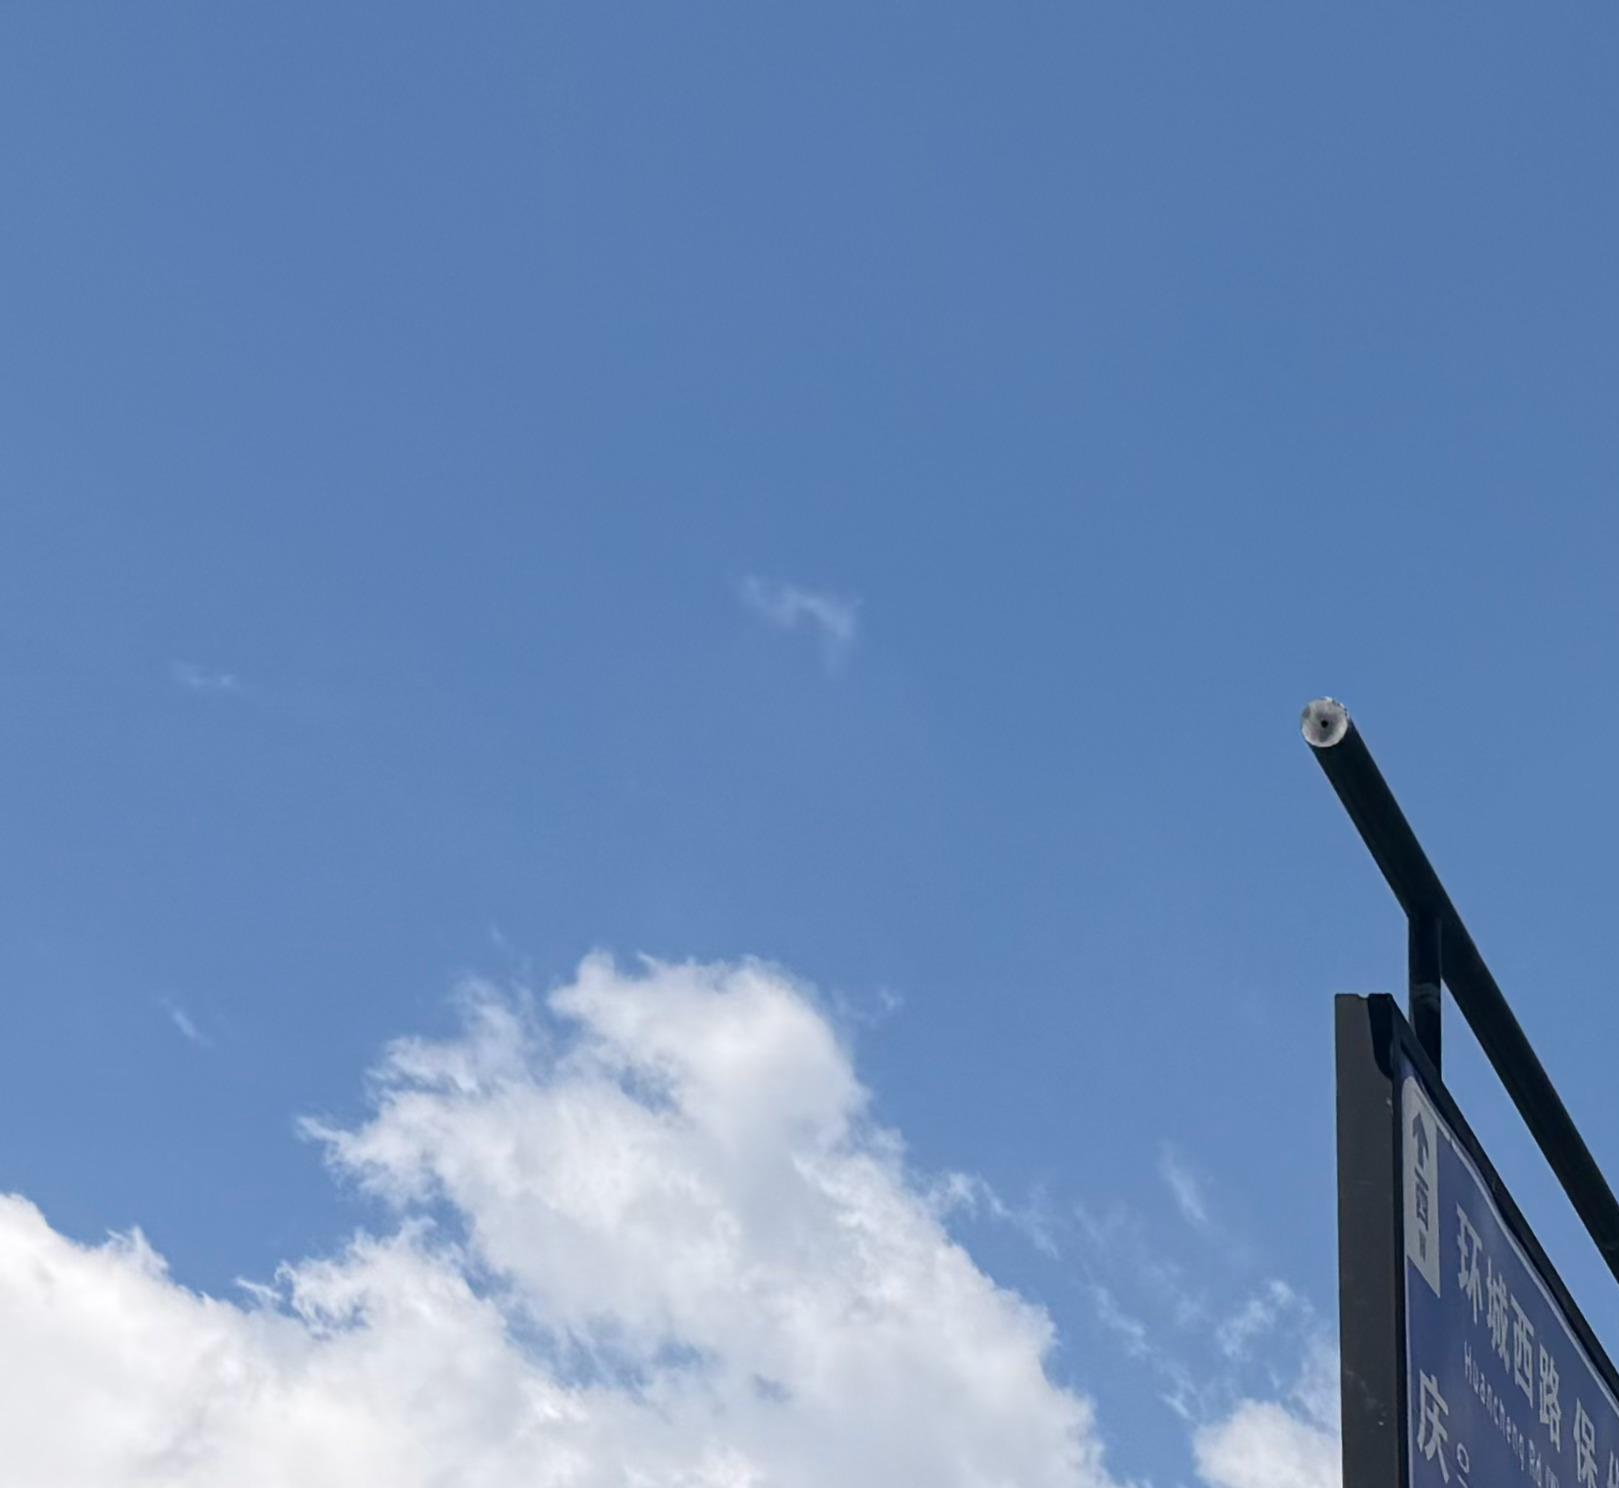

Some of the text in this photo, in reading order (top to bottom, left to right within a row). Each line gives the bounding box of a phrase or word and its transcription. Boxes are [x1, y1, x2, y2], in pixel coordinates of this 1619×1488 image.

[1456, 1202, 1562, 1453] 环城西路
[1464, 1341, 1525, 1472] Huancheng
